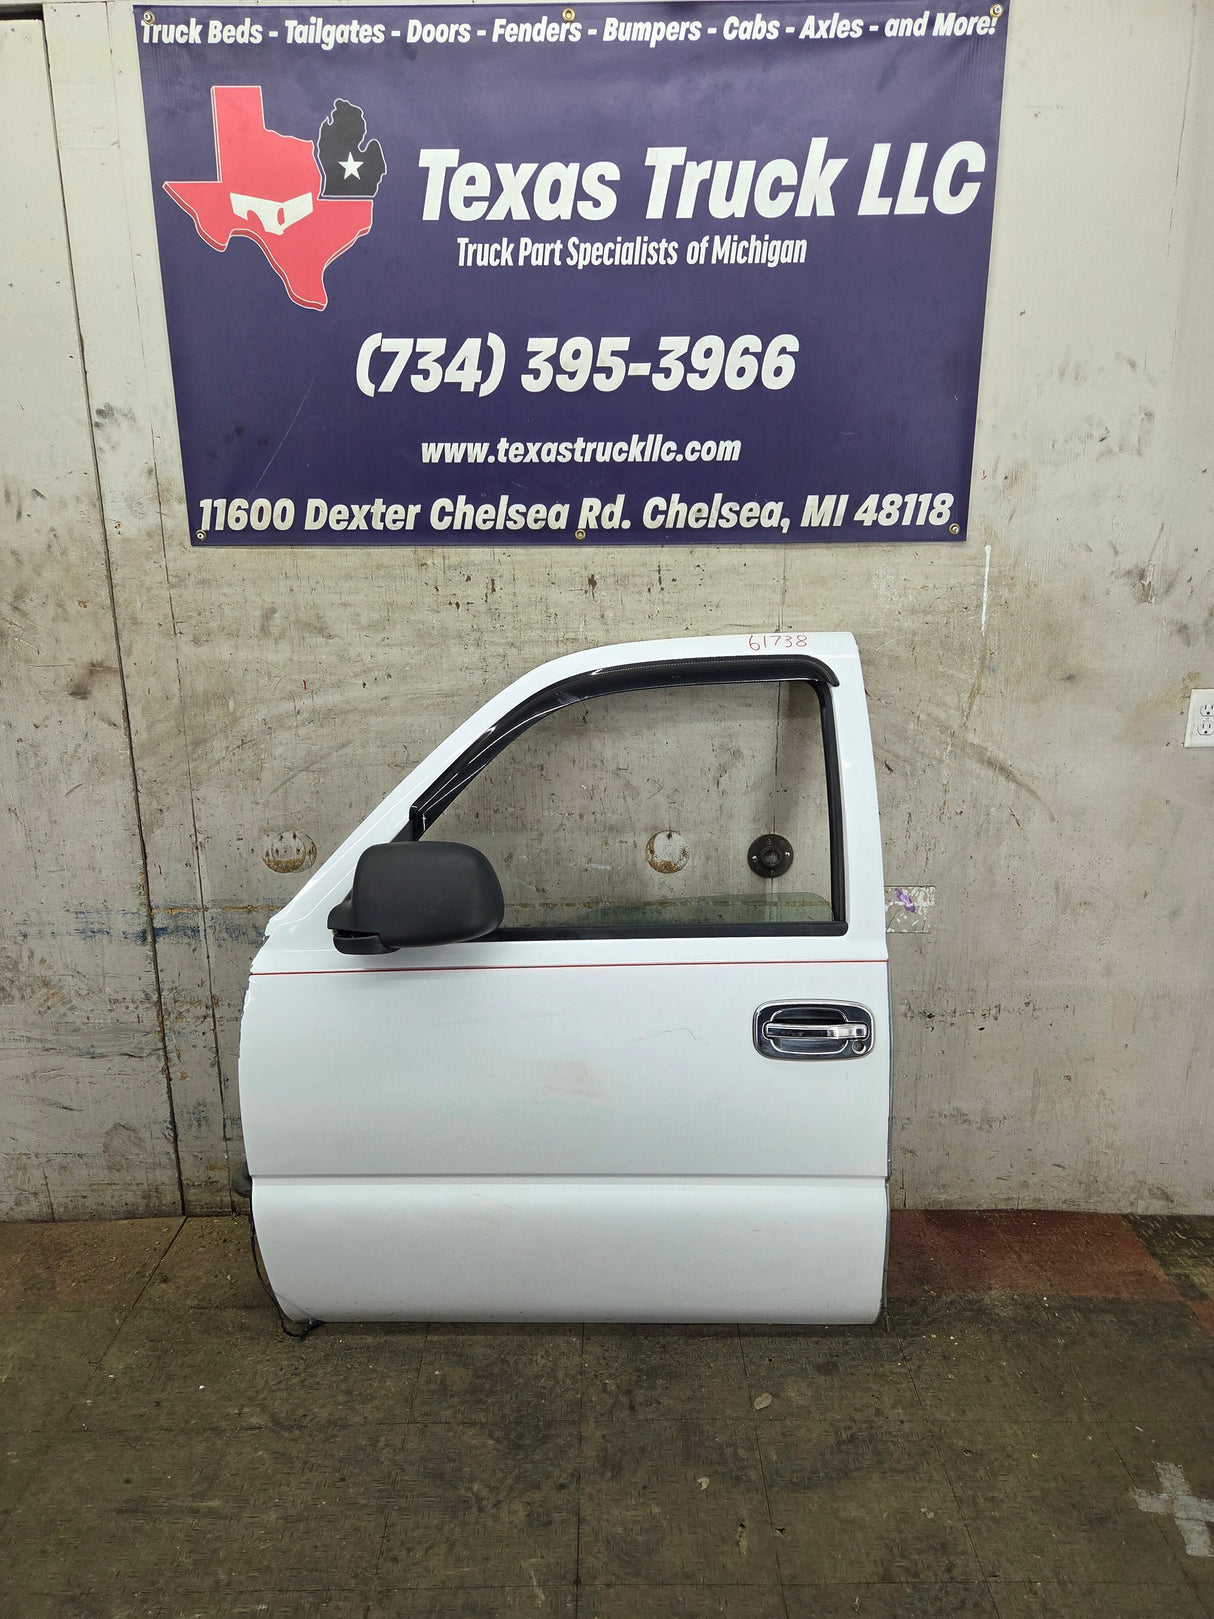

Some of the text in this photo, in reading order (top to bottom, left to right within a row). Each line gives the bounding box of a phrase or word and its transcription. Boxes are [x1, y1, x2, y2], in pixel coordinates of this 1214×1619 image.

[140, 18, 202, 44] Truck
[207, 18, 263, 44] Beds
[285, 16, 386, 50] Tailgates
[406, 18, 472, 45] Doors
[491, 16, 583, 44] Fenders
[602, 17, 703, 48] Bumpers
[722, 13, 780, 41] Cabs
[799, 12, 864, 40] Axles
[884, 11, 930, 38] and
[932, 11, 998, 37] More!
[417, 136, 987, 223] Texas Truck LLC
[456, 232, 808, 270] Truck Part Specialists of Michigan
[355, 330, 801, 398] (734) 395-3966
[420, 432, 743, 464] www.texastruckllc.com
[198, 491, 955, 534] 11600 Dexter Chelsea Rd. Chelsea, MI 48118
[748, 634, 809, 652] 61738
